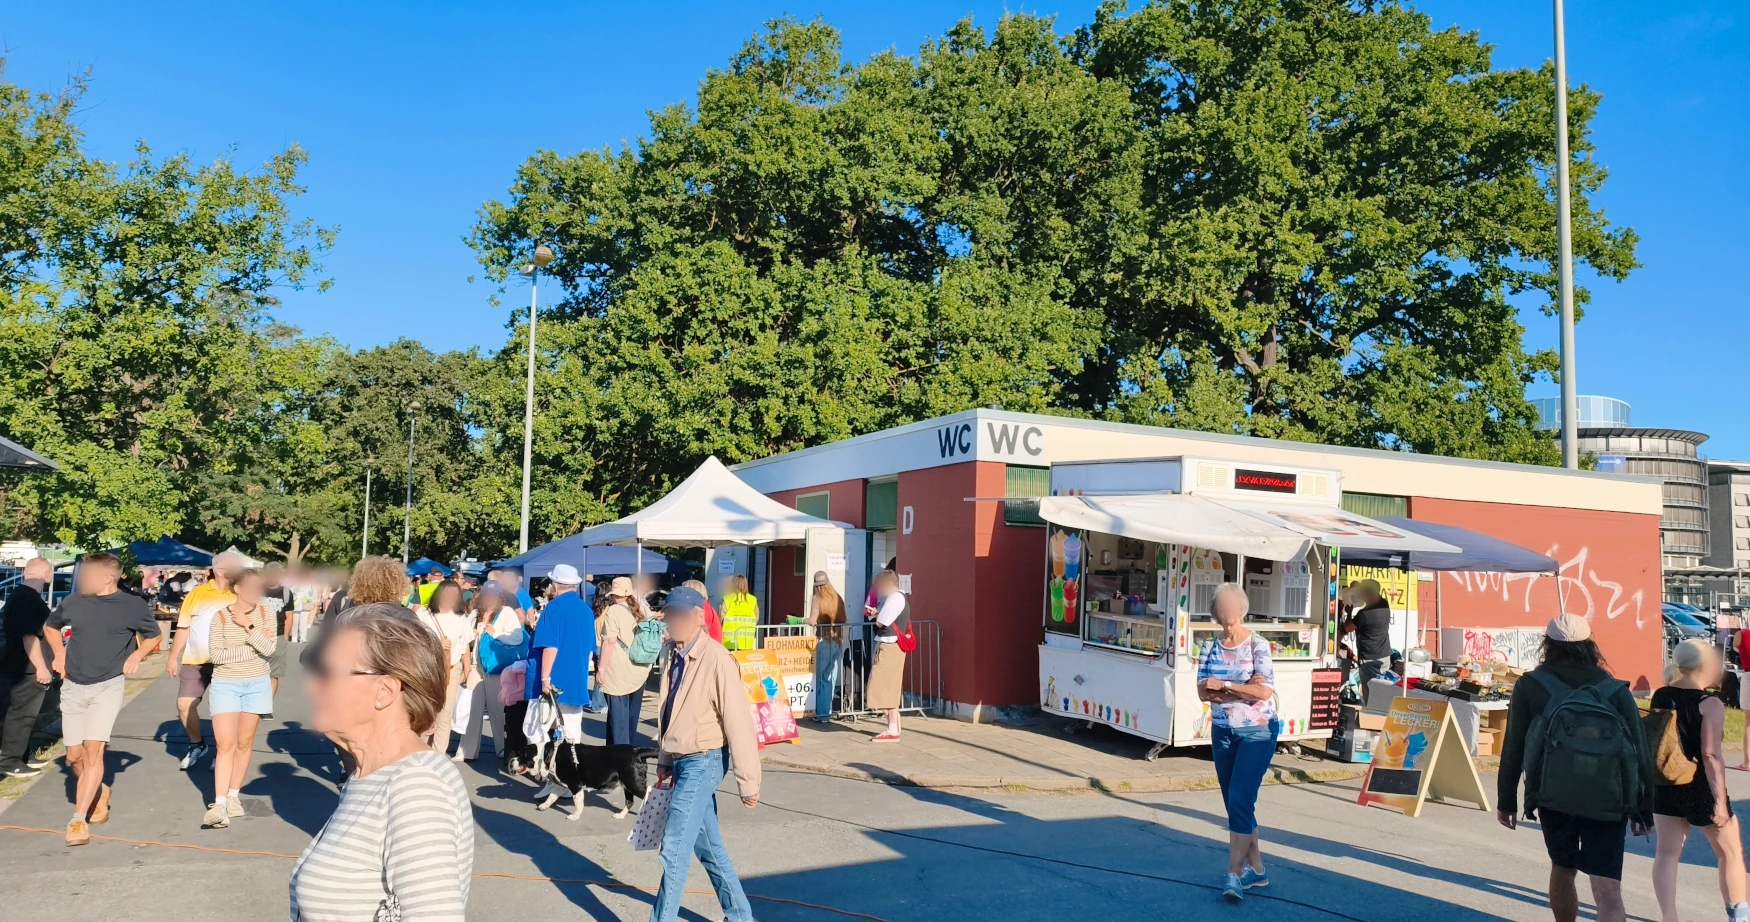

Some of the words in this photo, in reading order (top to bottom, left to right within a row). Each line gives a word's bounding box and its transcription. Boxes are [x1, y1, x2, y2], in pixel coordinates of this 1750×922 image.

[938, 423, 972, 459] WC
[986, 422, 1043, 456] WC
[902, 505, 914, 535] D
[767, 639, 815, 651] FLOHMARKT
[778, 656, 814, 666] RZ+HEIDE
[790, 696, 806, 706] PT.
